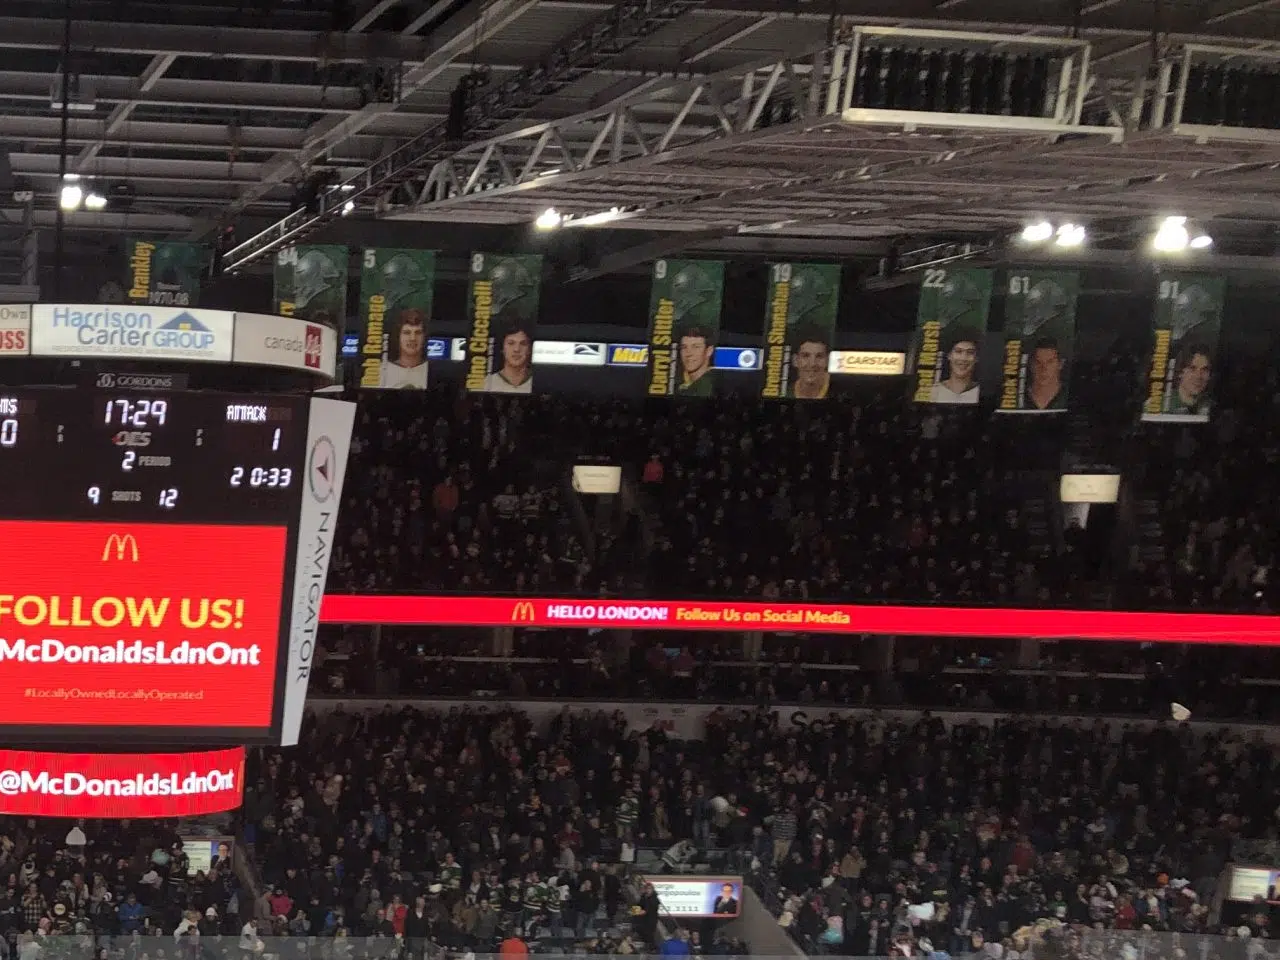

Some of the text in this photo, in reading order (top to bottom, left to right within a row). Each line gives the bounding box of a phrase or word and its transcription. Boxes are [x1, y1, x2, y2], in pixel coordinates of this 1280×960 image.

[364, 250, 376, 268] 5
[473, 254, 484, 272] 8
[655, 260, 667, 279] 9
[773, 264, 792, 282] 19
[923, 269, 946, 288] 22
[0, 306, 28, 320] Own
[52, 307, 152, 329] Harrison
[768, 282, 791, 345] Shanahan
[363, 295, 385, 354] Ramage
[77, 324, 215, 349] Carter GROUP
[264, 336, 304, 352] canada
[466, 281, 493, 389] Dino Ciccarelli
[921, 321, 940, 366] Marsh
[649, 299, 675, 395] Darryl Sittler
[847, 355, 900, 367] CARSTAR
[1005, 340, 1021, 376] Nash
[763, 345, 785, 396] Brendan
[104, 400, 168, 425] 17:29
[227, 405, 267, 421] ATTACK
[1, 419, 18, 445] 0
[271, 428, 281, 450] 1
[122, 451, 136, 470] 2
[139, 456, 171, 467] PERIOD
[230, 467, 291, 486] 2 0:33
[87, 487, 100, 504] 9
[159, 489, 179, 507] 12
[296, 511, 331, 684] NAVIGATOR
[180, 598, 245, 630] US!
[547, 605, 851, 625] HELLO LONDON! Follow Us on Social Media
[24, 686, 204, 703] #LocallyOwnedLocallyOperated
